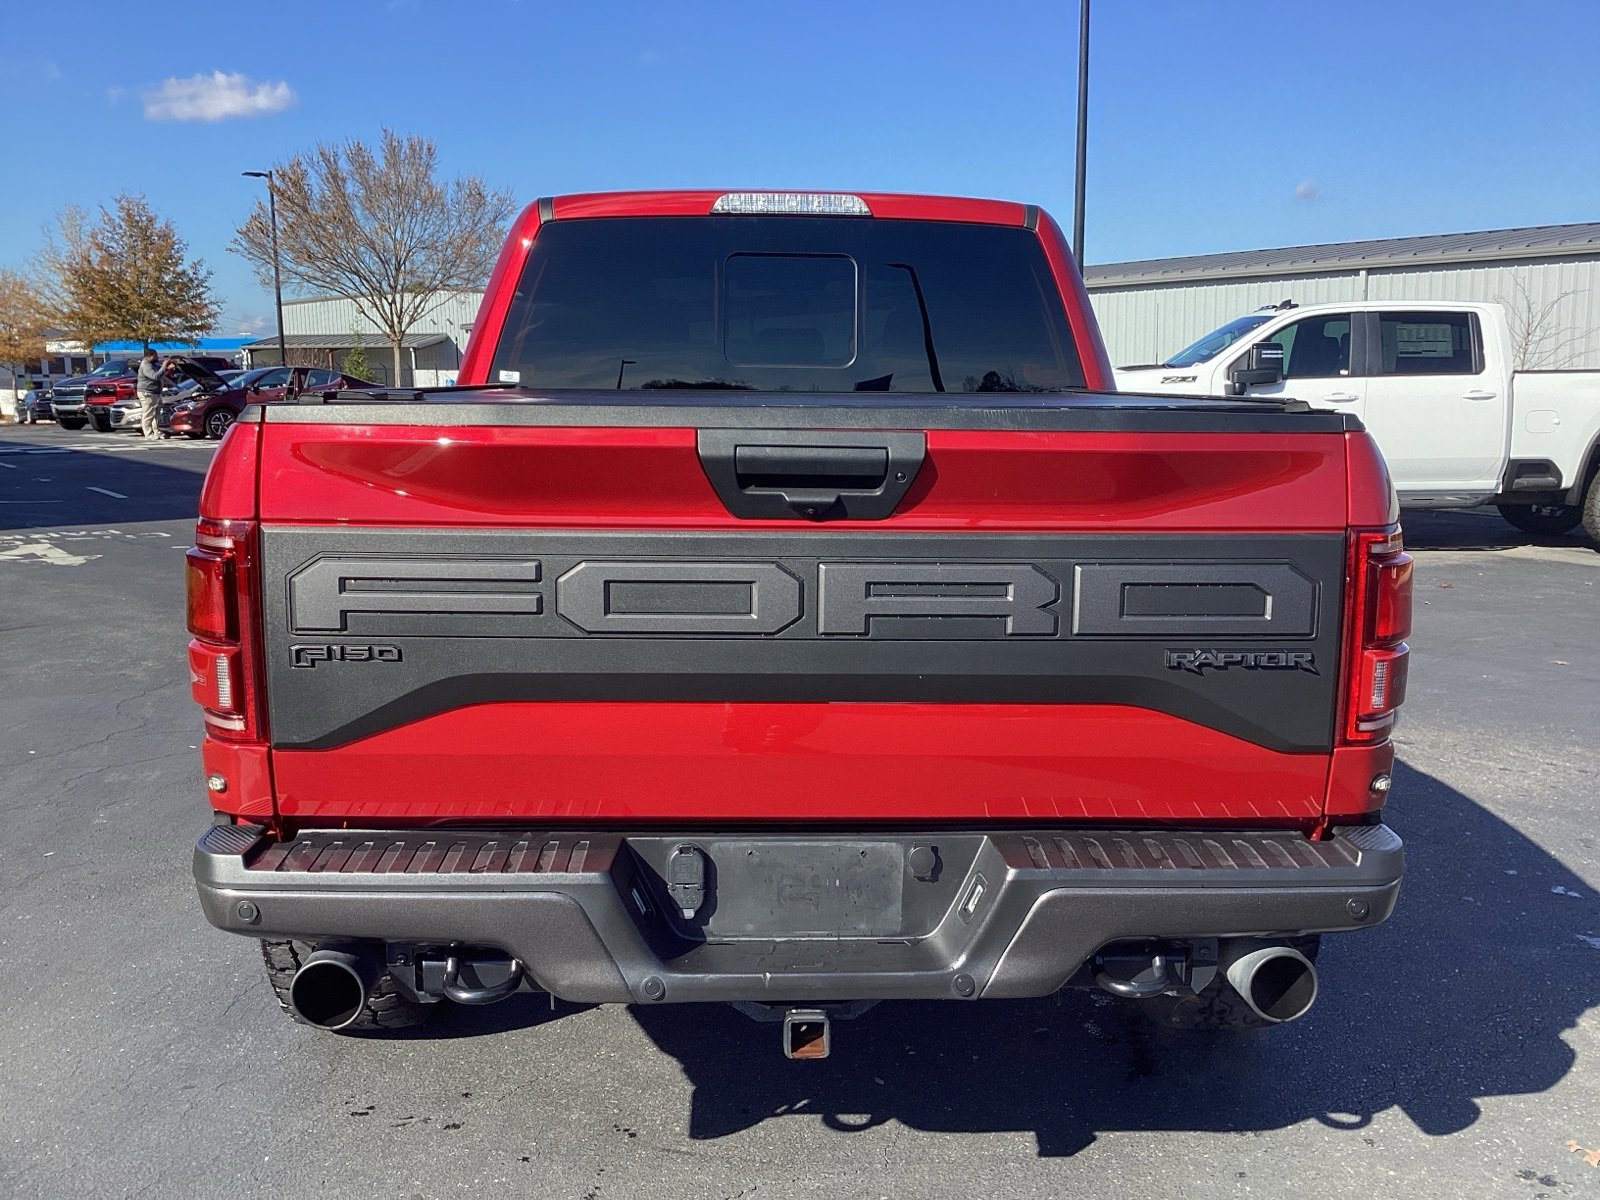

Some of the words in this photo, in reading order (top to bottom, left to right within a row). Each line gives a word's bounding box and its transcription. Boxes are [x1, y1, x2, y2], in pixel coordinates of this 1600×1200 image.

[289, 556, 1317, 637] FORD
[288, 643, 403, 668] F150
[1165, 649, 1321, 677] RAPTOR
